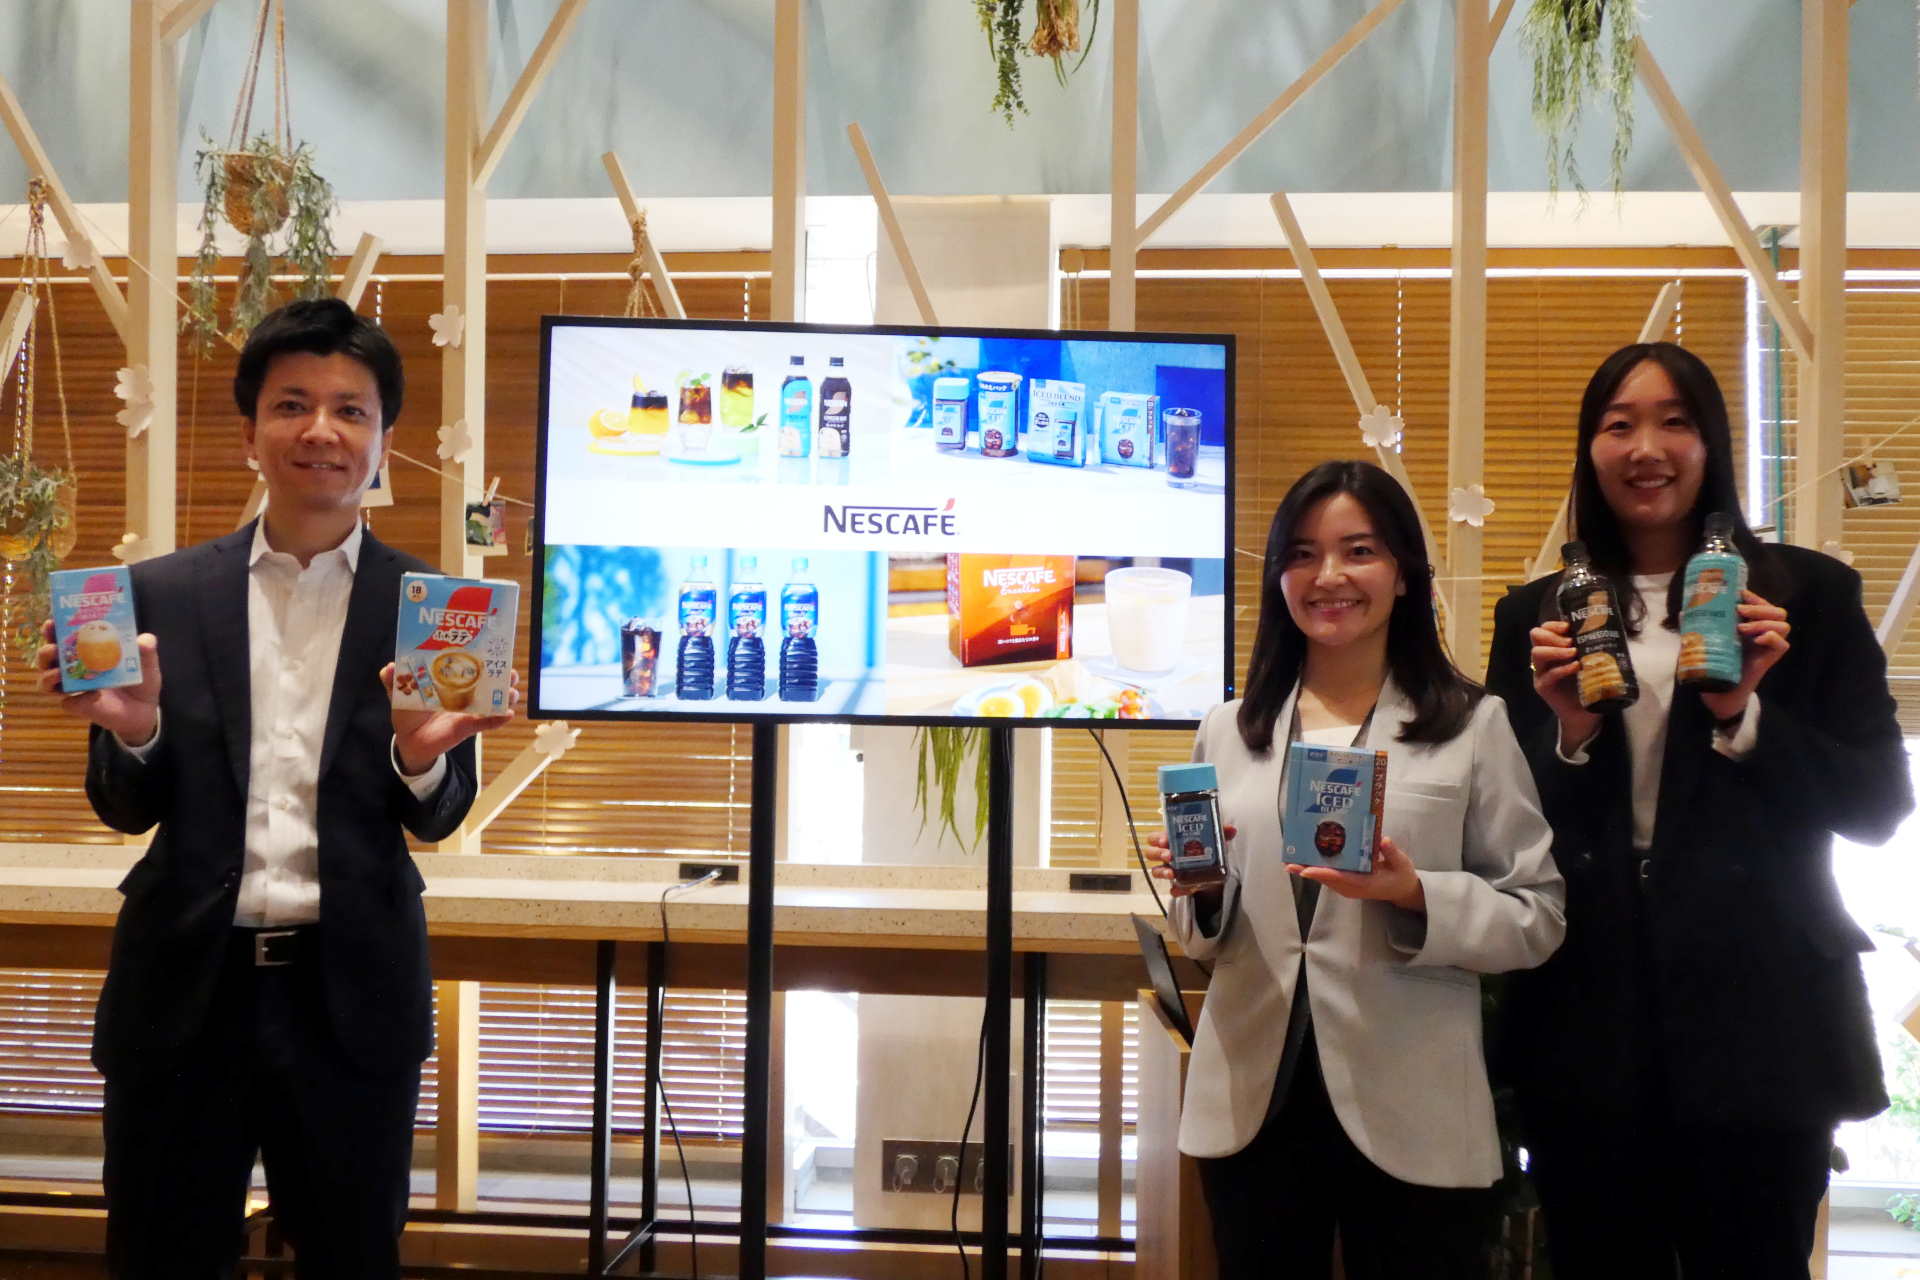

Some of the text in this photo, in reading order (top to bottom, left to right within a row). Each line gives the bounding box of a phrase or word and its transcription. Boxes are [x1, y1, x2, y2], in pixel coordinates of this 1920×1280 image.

[1033, 390, 1082, 402] ICED BLEND
[823, 498, 956, 536] NESCAFÉ
[412, 585, 422, 594] 18
[485, 659, 507, 669] アイス
[487, 669, 503, 678] ラテ
[1374, 758, 1386, 767] 20
[1310, 780, 1362, 797] NESCAFÉ
[1373, 774, 1383, 805] ブラック
[1316, 792, 1354, 809] ICED
[1178, 823, 1204, 834] ICED
